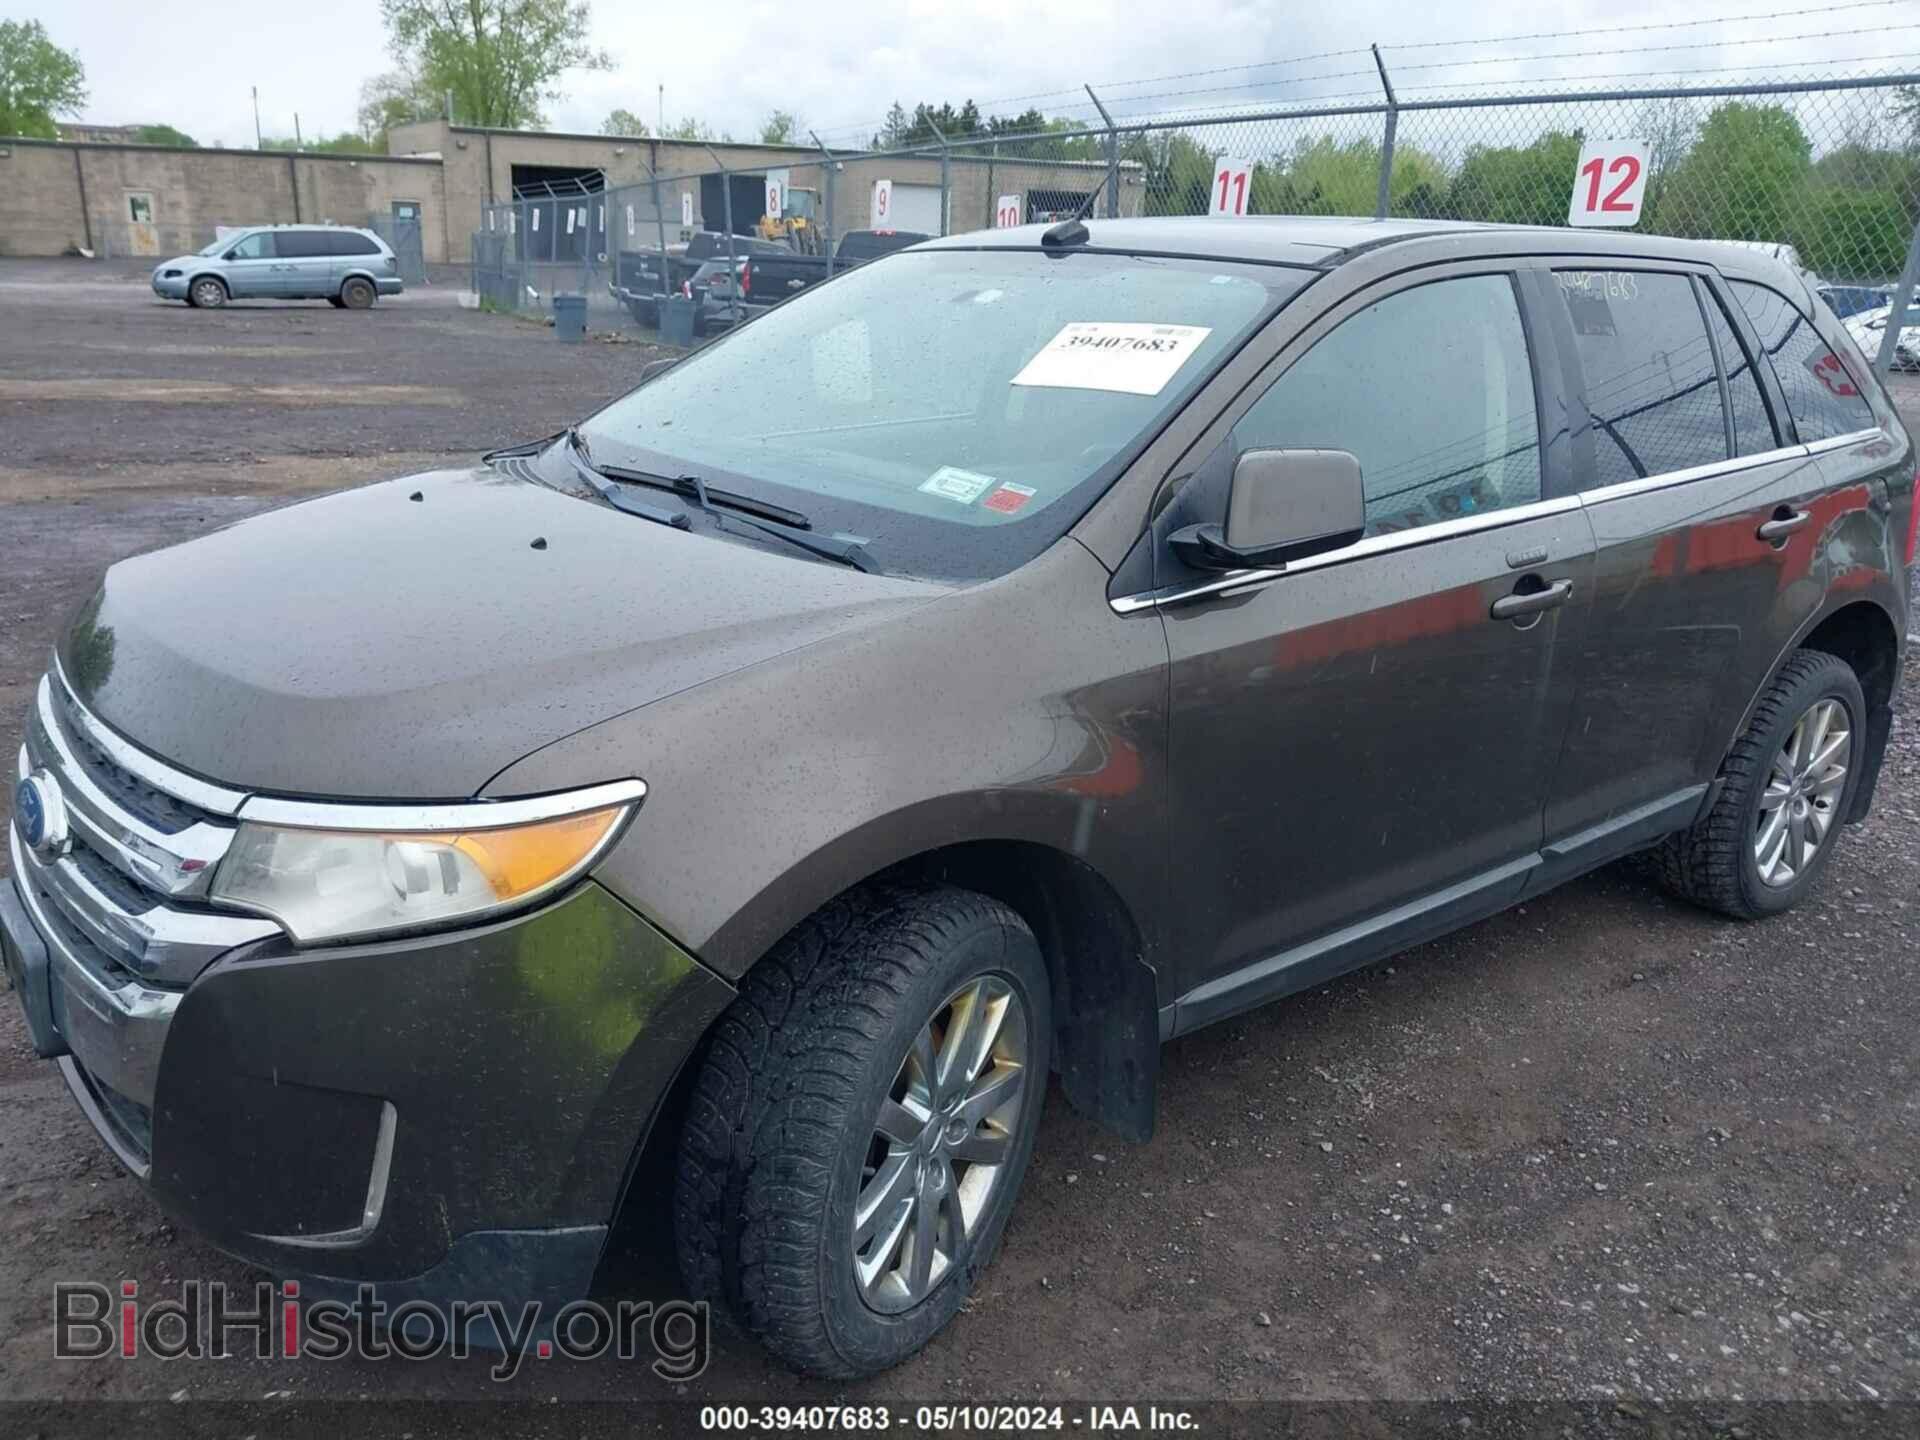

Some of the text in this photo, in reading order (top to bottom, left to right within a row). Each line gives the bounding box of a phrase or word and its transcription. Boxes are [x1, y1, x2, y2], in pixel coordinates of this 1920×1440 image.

[1219, 171, 1246, 215] 11
[1583, 156, 1640, 211] 12
[769, 188, 777, 212] 8
[879, 188, 887, 216] 9
[1061, 335, 1180, 352] 39407683
